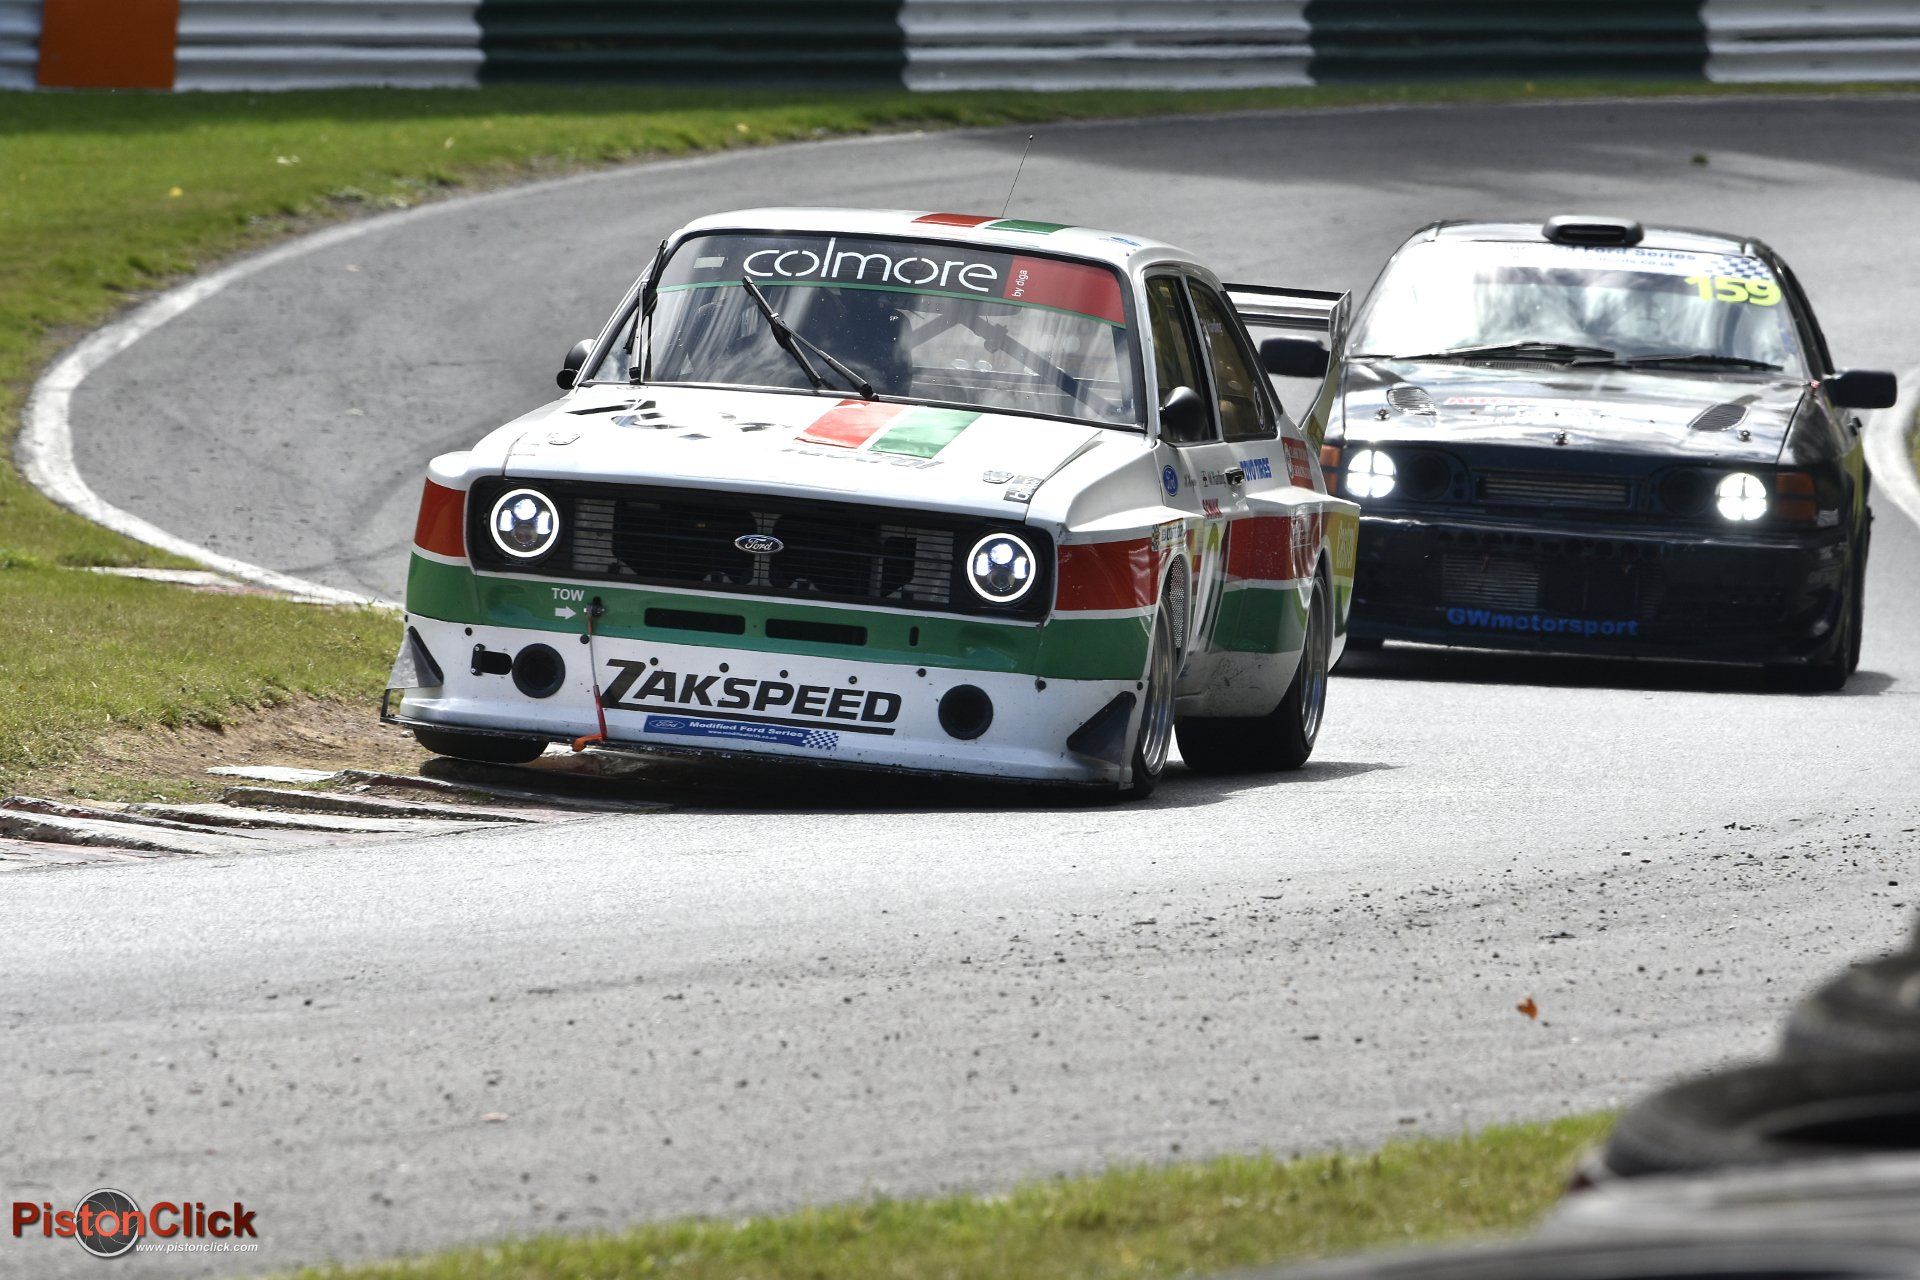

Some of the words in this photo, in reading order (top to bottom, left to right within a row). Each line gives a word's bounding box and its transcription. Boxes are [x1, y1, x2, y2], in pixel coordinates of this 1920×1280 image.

[1634, 249, 1697, 261] Series
[743, 237, 999, 292] colmore
[1015, 270, 1028, 286] diga
[1011, 286, 1024, 297] by
[1684, 276, 1782, 307] 159
[744, 537, 774, 551] Ford
[551, 587, 585, 602] TOW
[1446, 606, 1640, 637] GWmotorsport
[689, 721, 737, 731] Modified
[740, 725, 765, 734] Ford
[768, 728, 804, 738] Series
